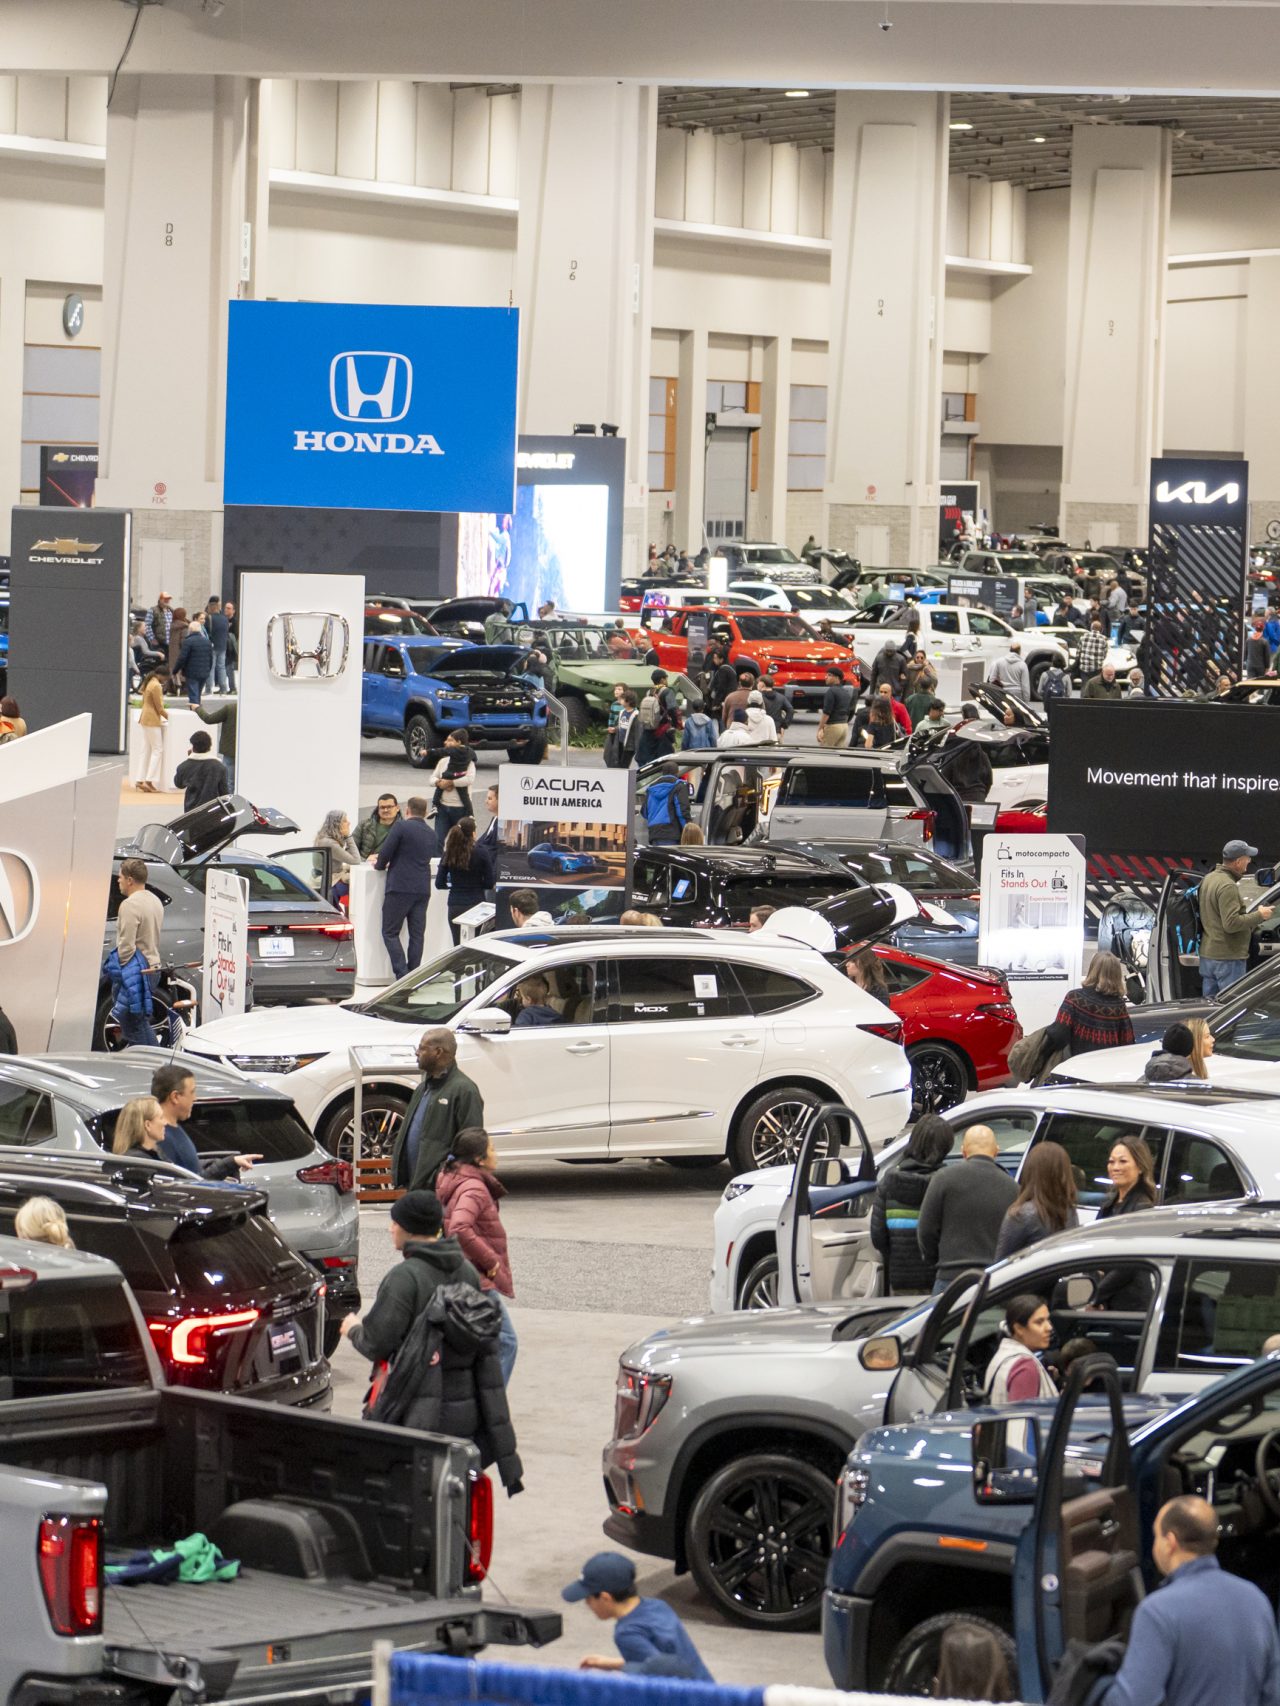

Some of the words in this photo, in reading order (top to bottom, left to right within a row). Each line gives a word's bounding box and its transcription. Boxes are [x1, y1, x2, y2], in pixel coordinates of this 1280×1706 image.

[166, 223, 174, 234] D
[165, 235, 173, 246] 8
[293, 431, 445, 455] HONDA
[1157, 481, 1239, 504] KIA
[28, 555, 104, 565] CHEVROLET
[1087, 767, 1178, 787] Movement
[1183, 771, 1217, 789] that
[535, 778, 605, 793] ACURA
[523, 796, 548, 806] BUILT
[550, 797, 560, 807] IN
[561, 798, 603, 808] AMERICA
[1015, 850, 1070, 858] motocompacto
[1001, 869, 1015, 878] Fits
[1016, 869, 1024, 878] In
[1001, 879, 1029, 888] Stands
[1031, 880, 1047, 888] Out
[271, 1330, 296, 1349] GMC
